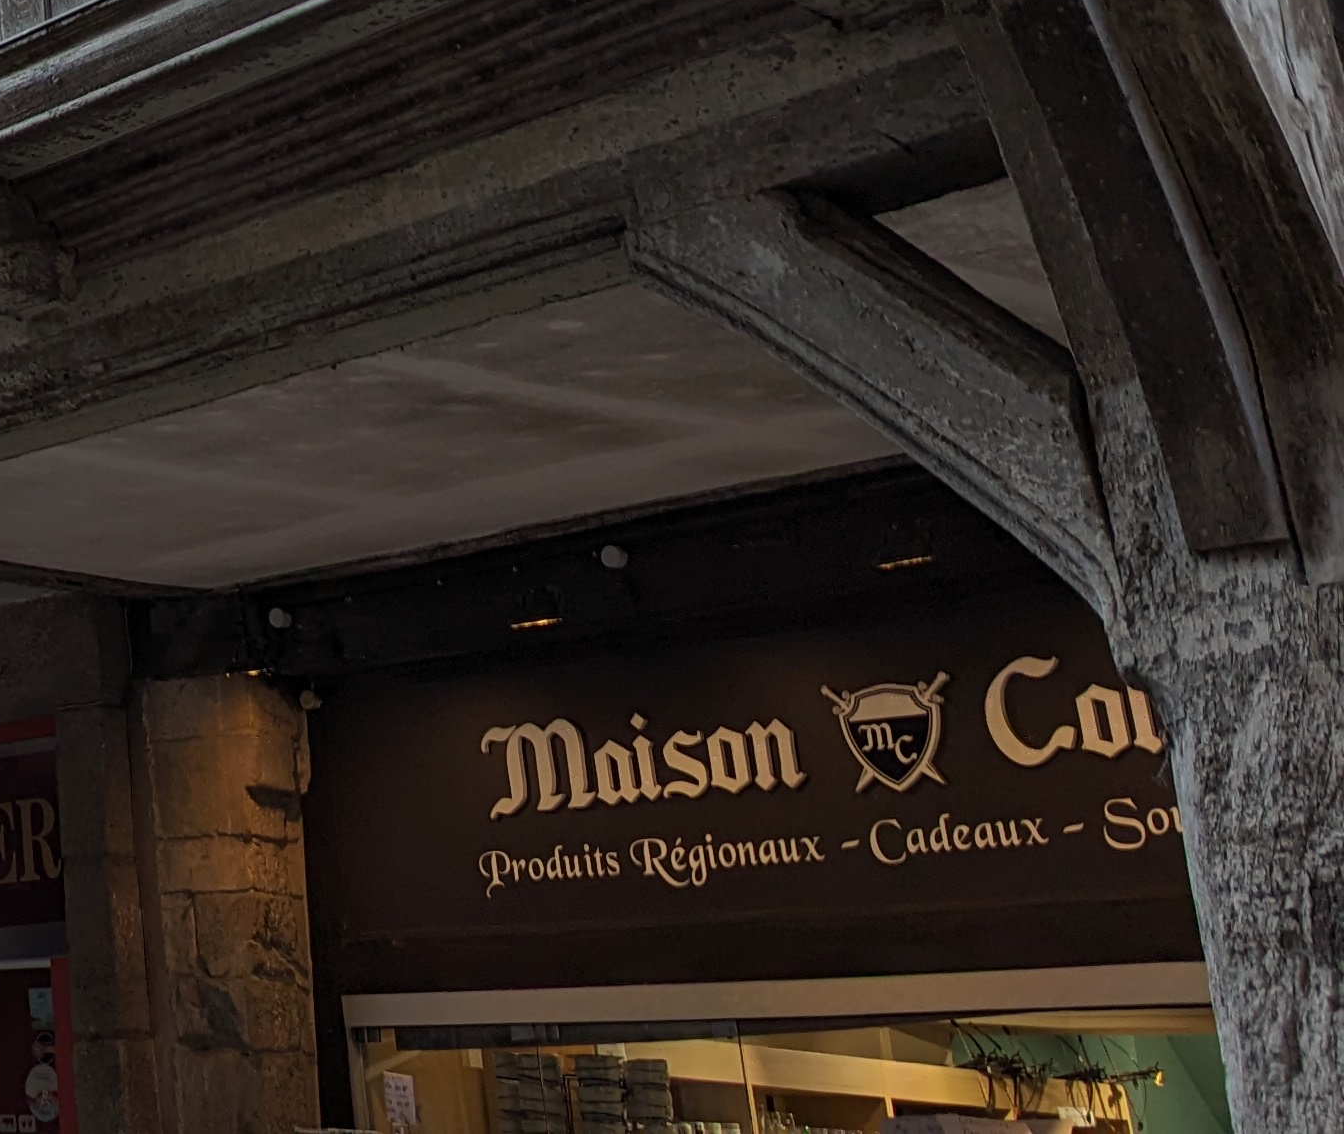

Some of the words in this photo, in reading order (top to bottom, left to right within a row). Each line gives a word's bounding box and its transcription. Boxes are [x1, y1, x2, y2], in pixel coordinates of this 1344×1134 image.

[480, 712, 808, 821] Maison
[479, 843, 621, 900] Produits
[630, 833, 826, 890] Régionaux
[869, 812, 1050, 866] Cadeaux
